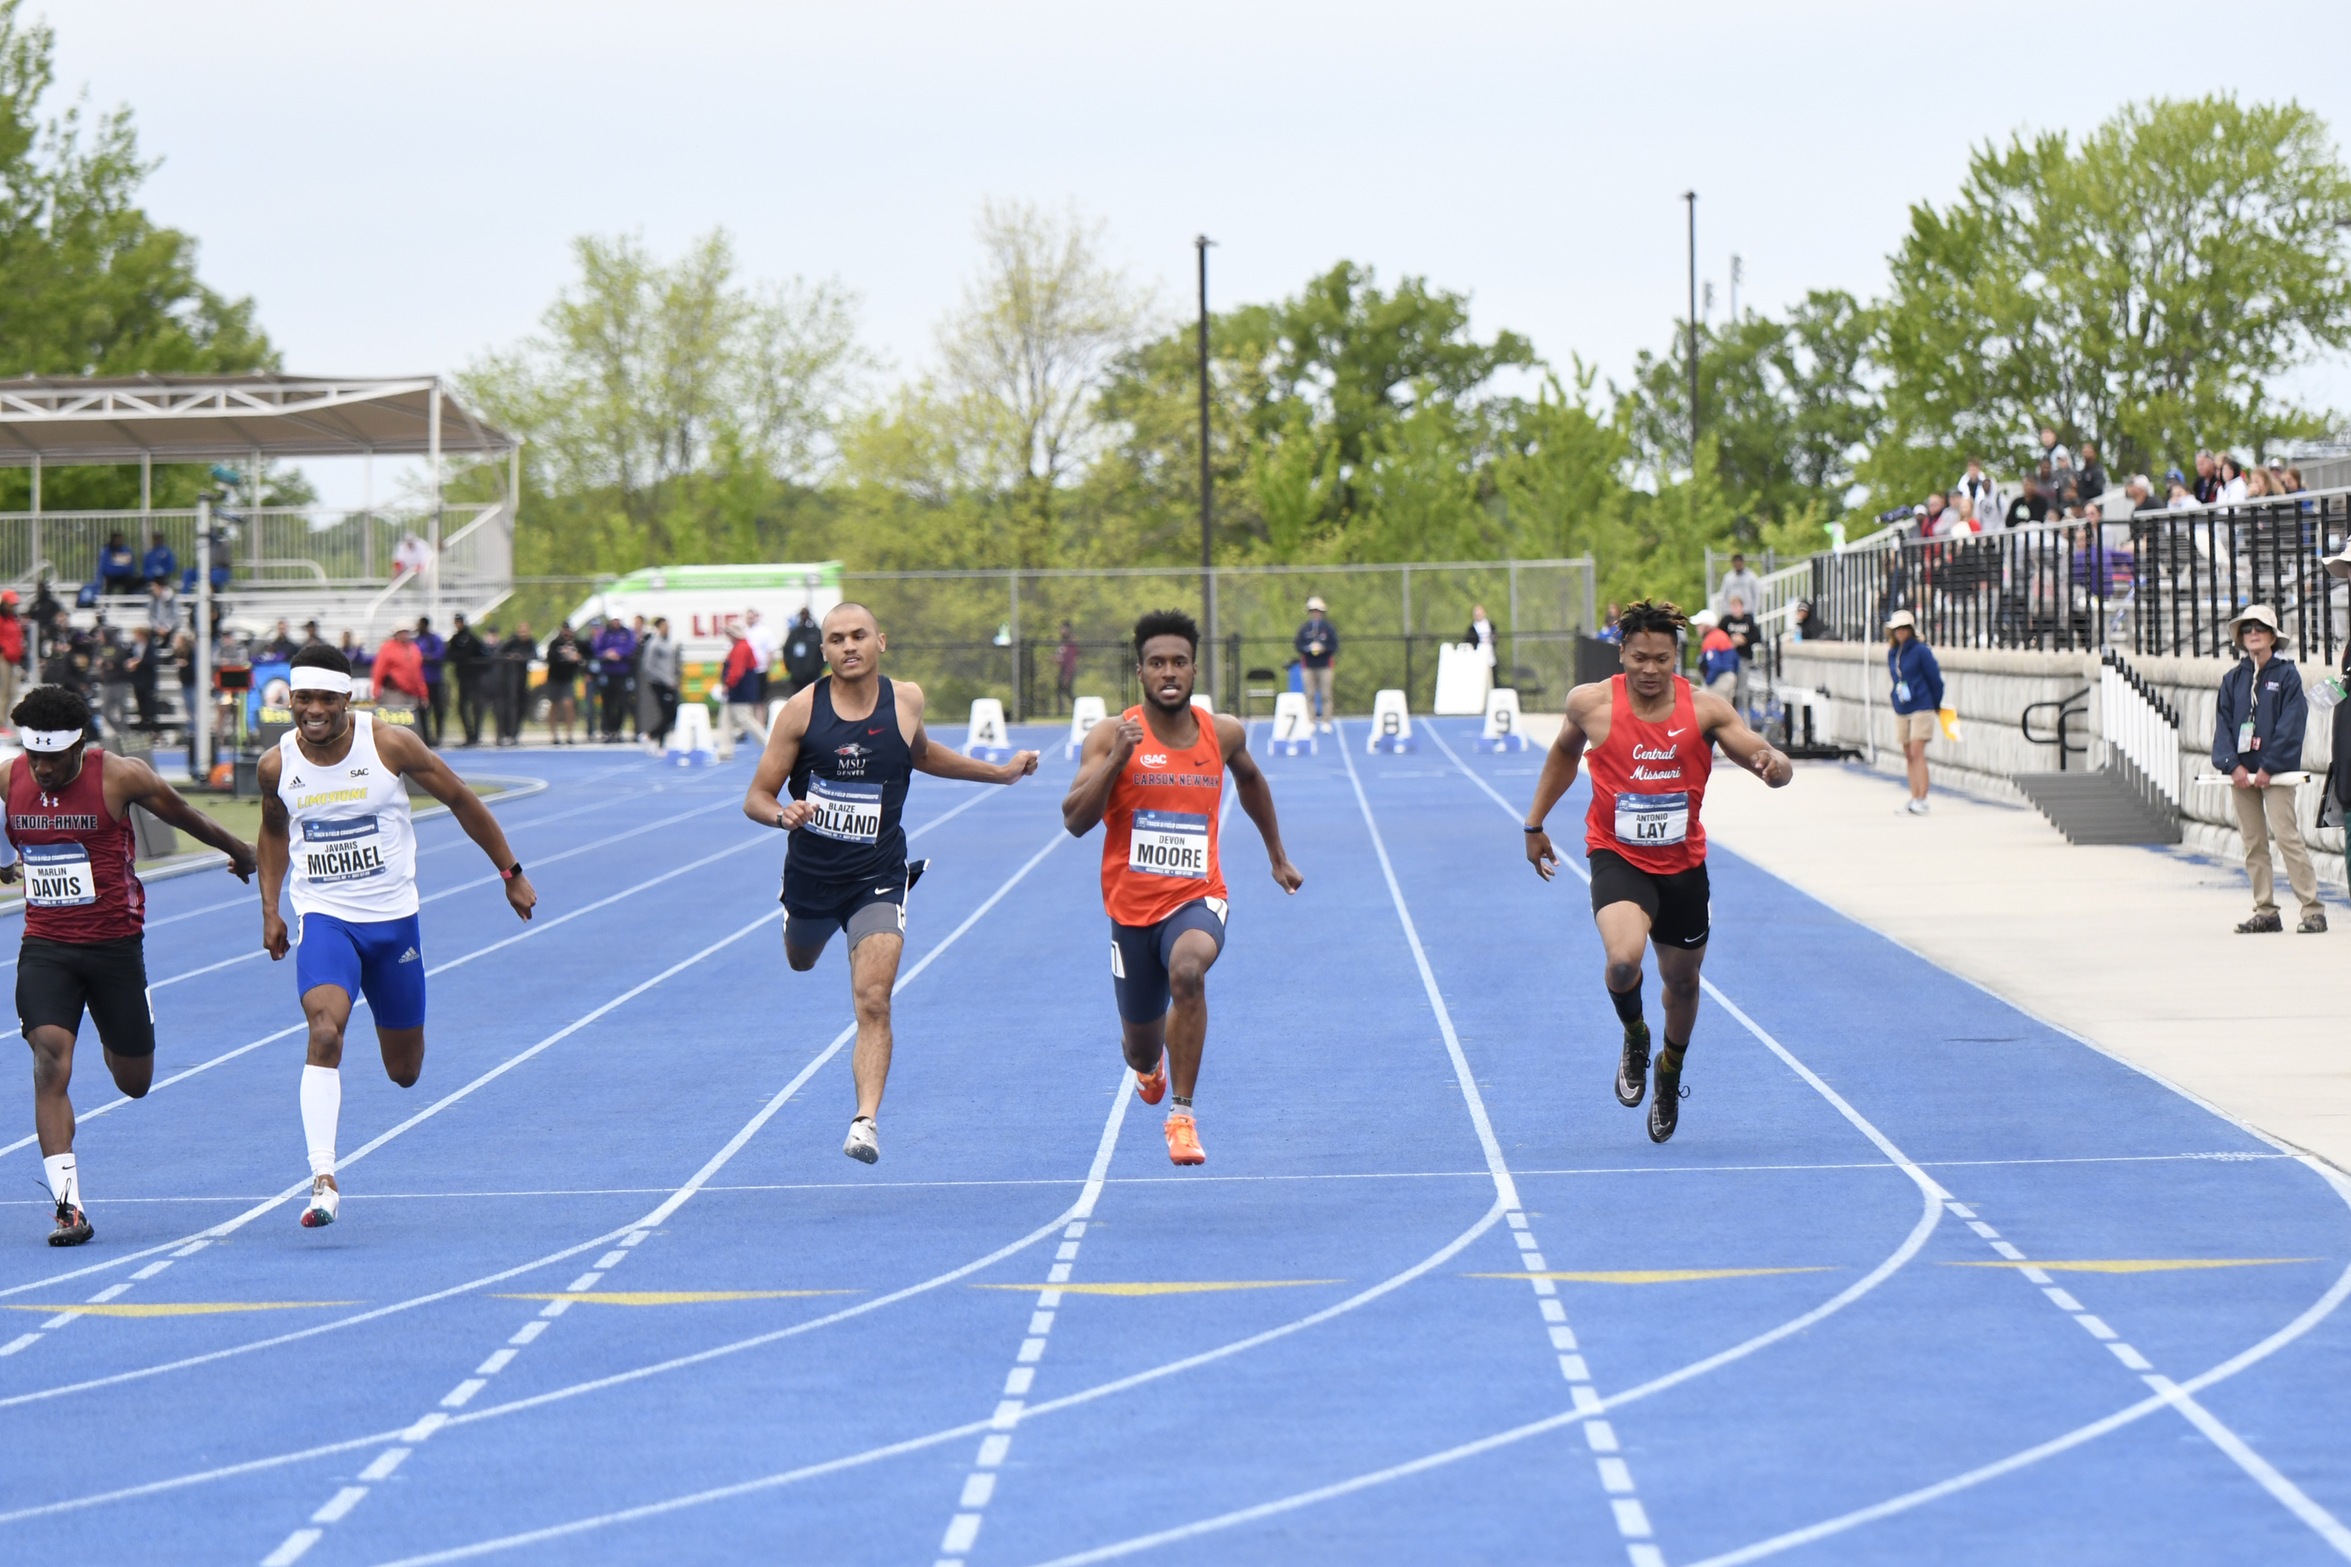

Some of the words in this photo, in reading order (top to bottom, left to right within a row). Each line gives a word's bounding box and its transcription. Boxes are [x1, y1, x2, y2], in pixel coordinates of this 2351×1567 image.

[1285, 714, 1298, 738] 7
[1383, 713, 1399, 735] 8
[1495, 710, 1511, 734] 9
[978, 721, 994, 742] 4
[1143, 754, 1167, 765] SAC
[1632, 743, 1677, 760] Central
[838, 759, 866, 769] MSU
[350, 768, 370, 778] SAC
[1629, 765, 1681, 781] Missouri
[297, 786, 369, 810] LIMESTONE
[828, 802, 856, 813] BLAIZE
[1636, 812, 1668, 822] ANTONIO
[1636, 822, 1668, 839] LAY
[324, 841, 358, 853] JAVARIS
[1158, 835, 1186, 845] DEVON
[307, 845, 385, 875] MICHAEL
[1137, 843, 1202, 869] MOORE
[37, 866, 67, 877] MARLIN
[31, 876, 81, 898] DAVIS
